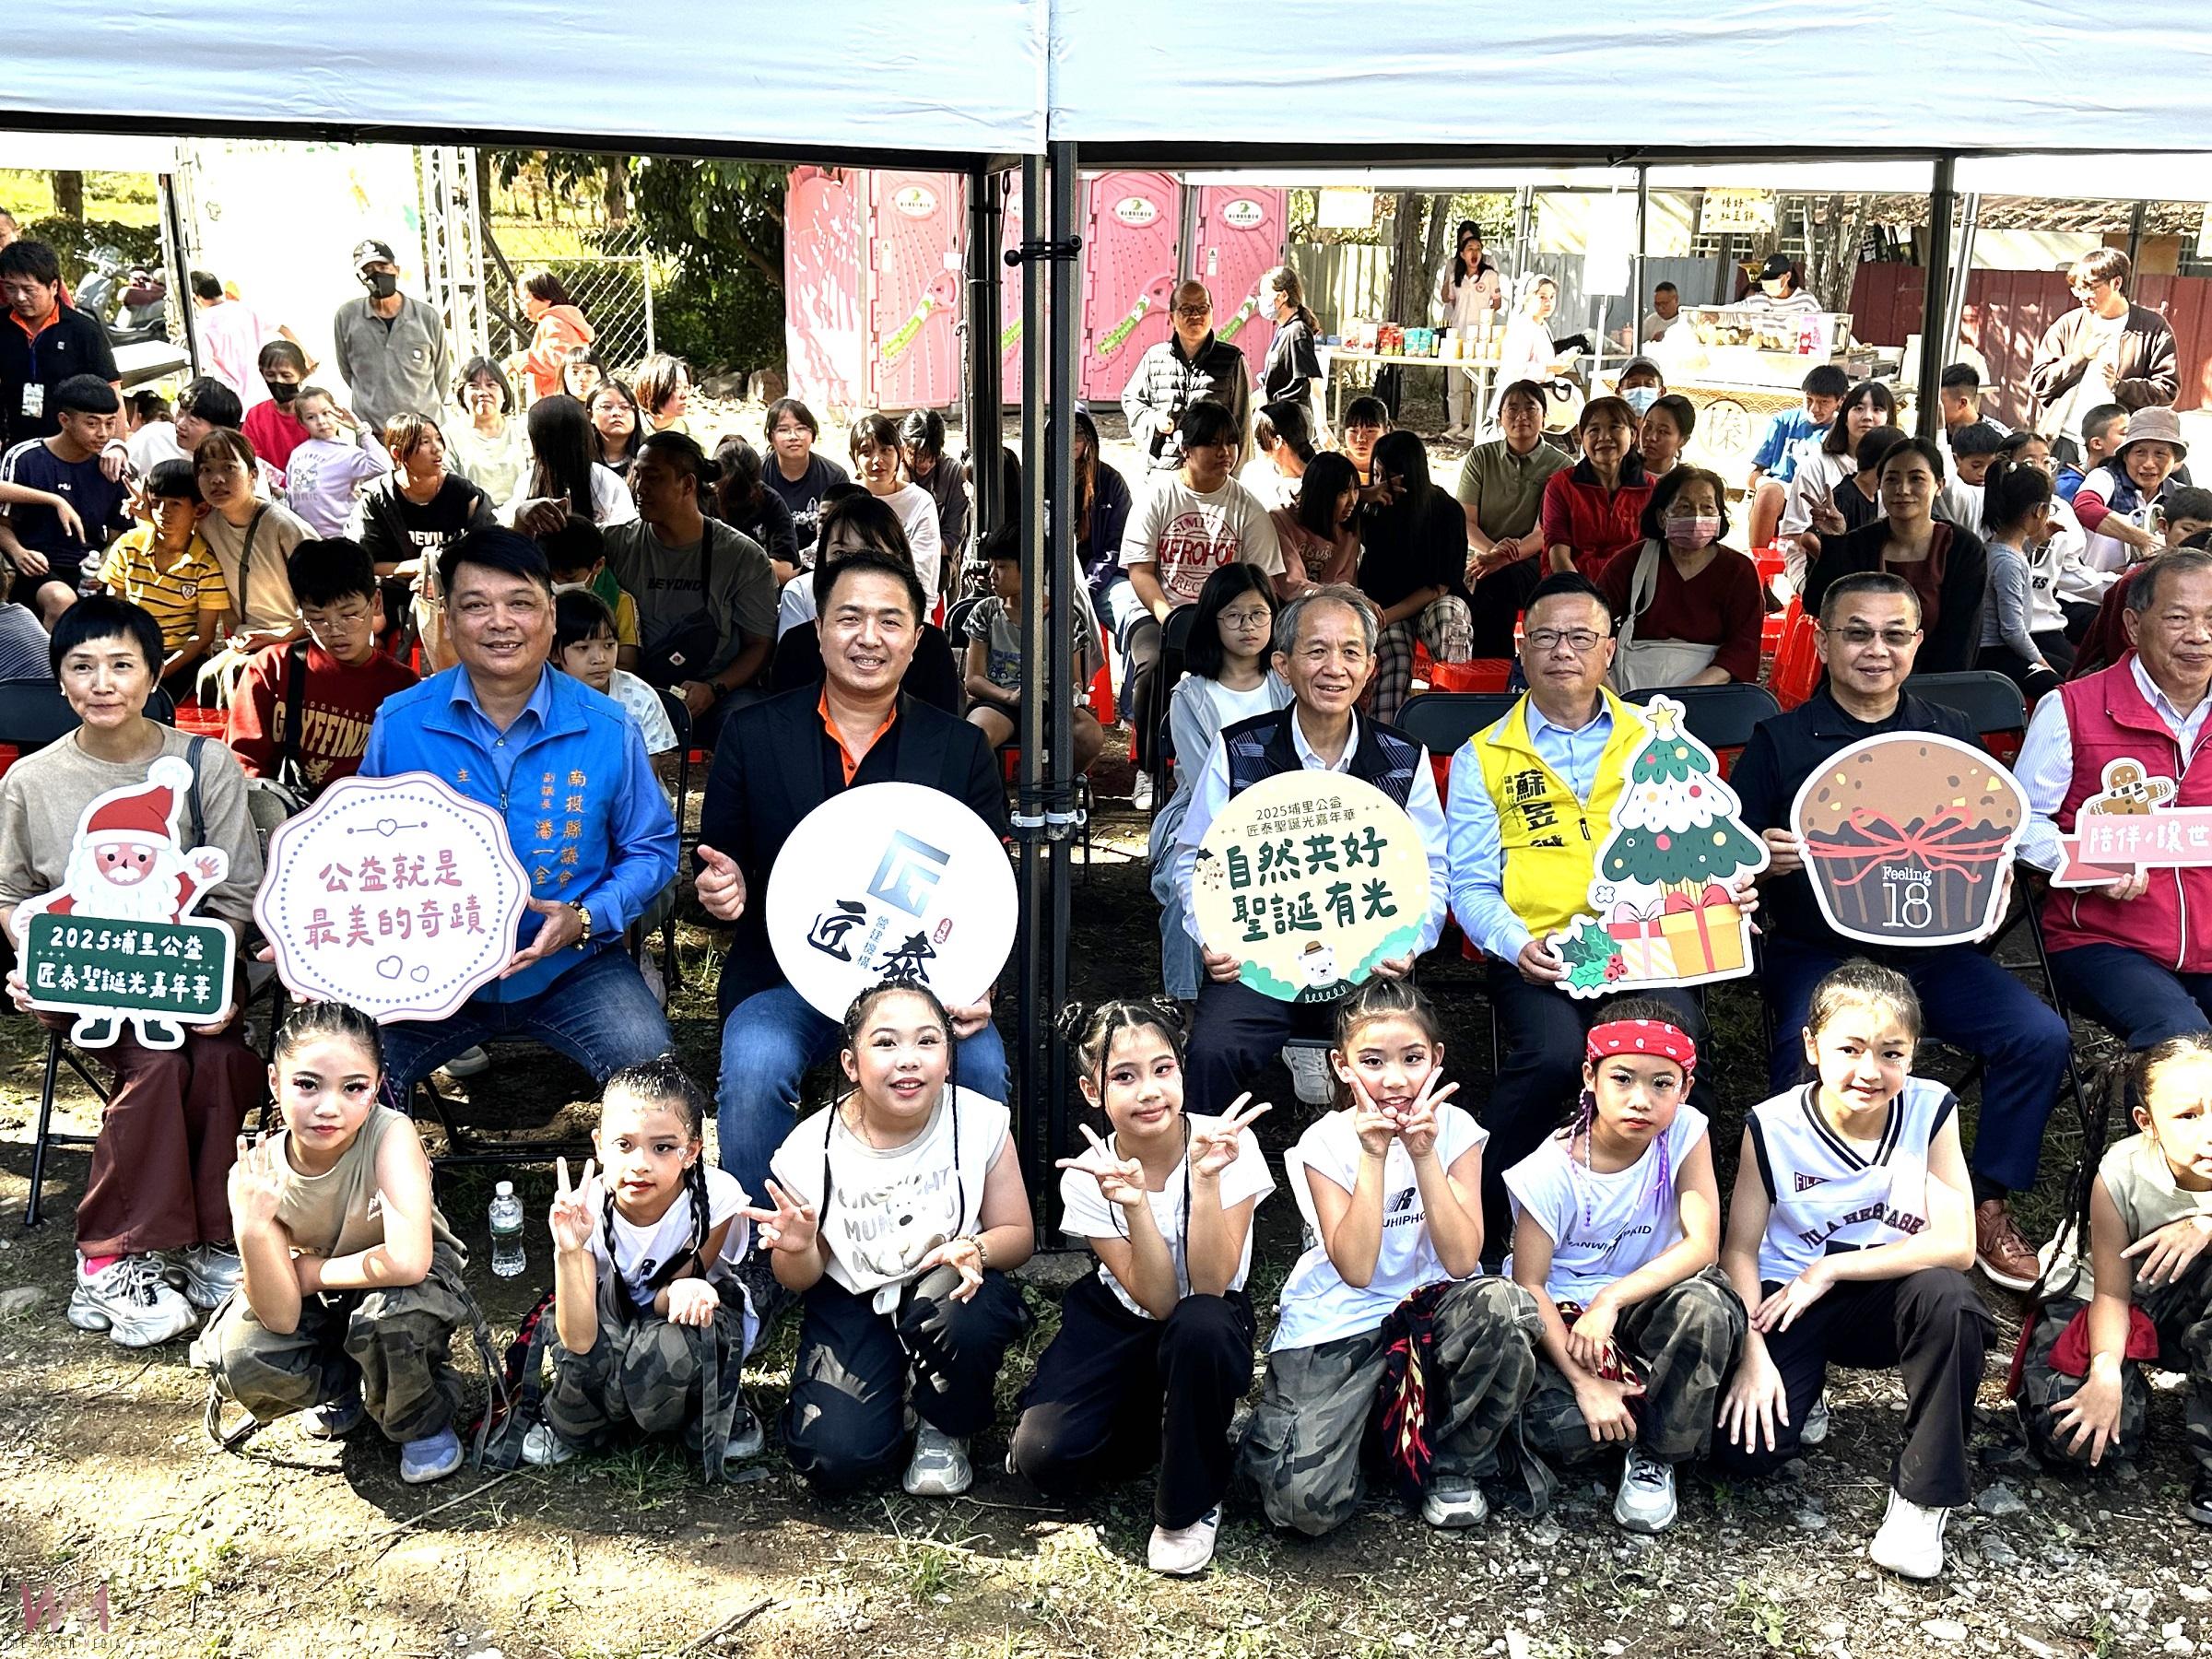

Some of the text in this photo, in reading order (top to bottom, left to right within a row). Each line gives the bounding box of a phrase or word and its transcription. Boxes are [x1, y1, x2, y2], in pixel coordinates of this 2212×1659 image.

[273, 701, 373, 758] GYFFIND
[302, 700, 370, 722] OGWART
[558, 770, 588, 889] 南投縣議會
[1246, 808, 1356, 837] 匠泰聖誕光嘉年華
[1255, 795, 1343, 821] 2025埔里公益
[318, 848, 463, 892] 公益就是
[531, 819, 556, 885] 潘一全
[1226, 826, 1388, 890] 自然共好
[1882, 865, 1933, 887] Feeling
[303, 893, 487, 950] 最美的奇蹟
[1231, 877, 1398, 943] 聖誕有光
[1882, 882, 1933, 929] 18
[50, 925, 204, 960] 2025埔里公益
[36, 961, 211, 1005] 匠泰聖誕光嘉年華
